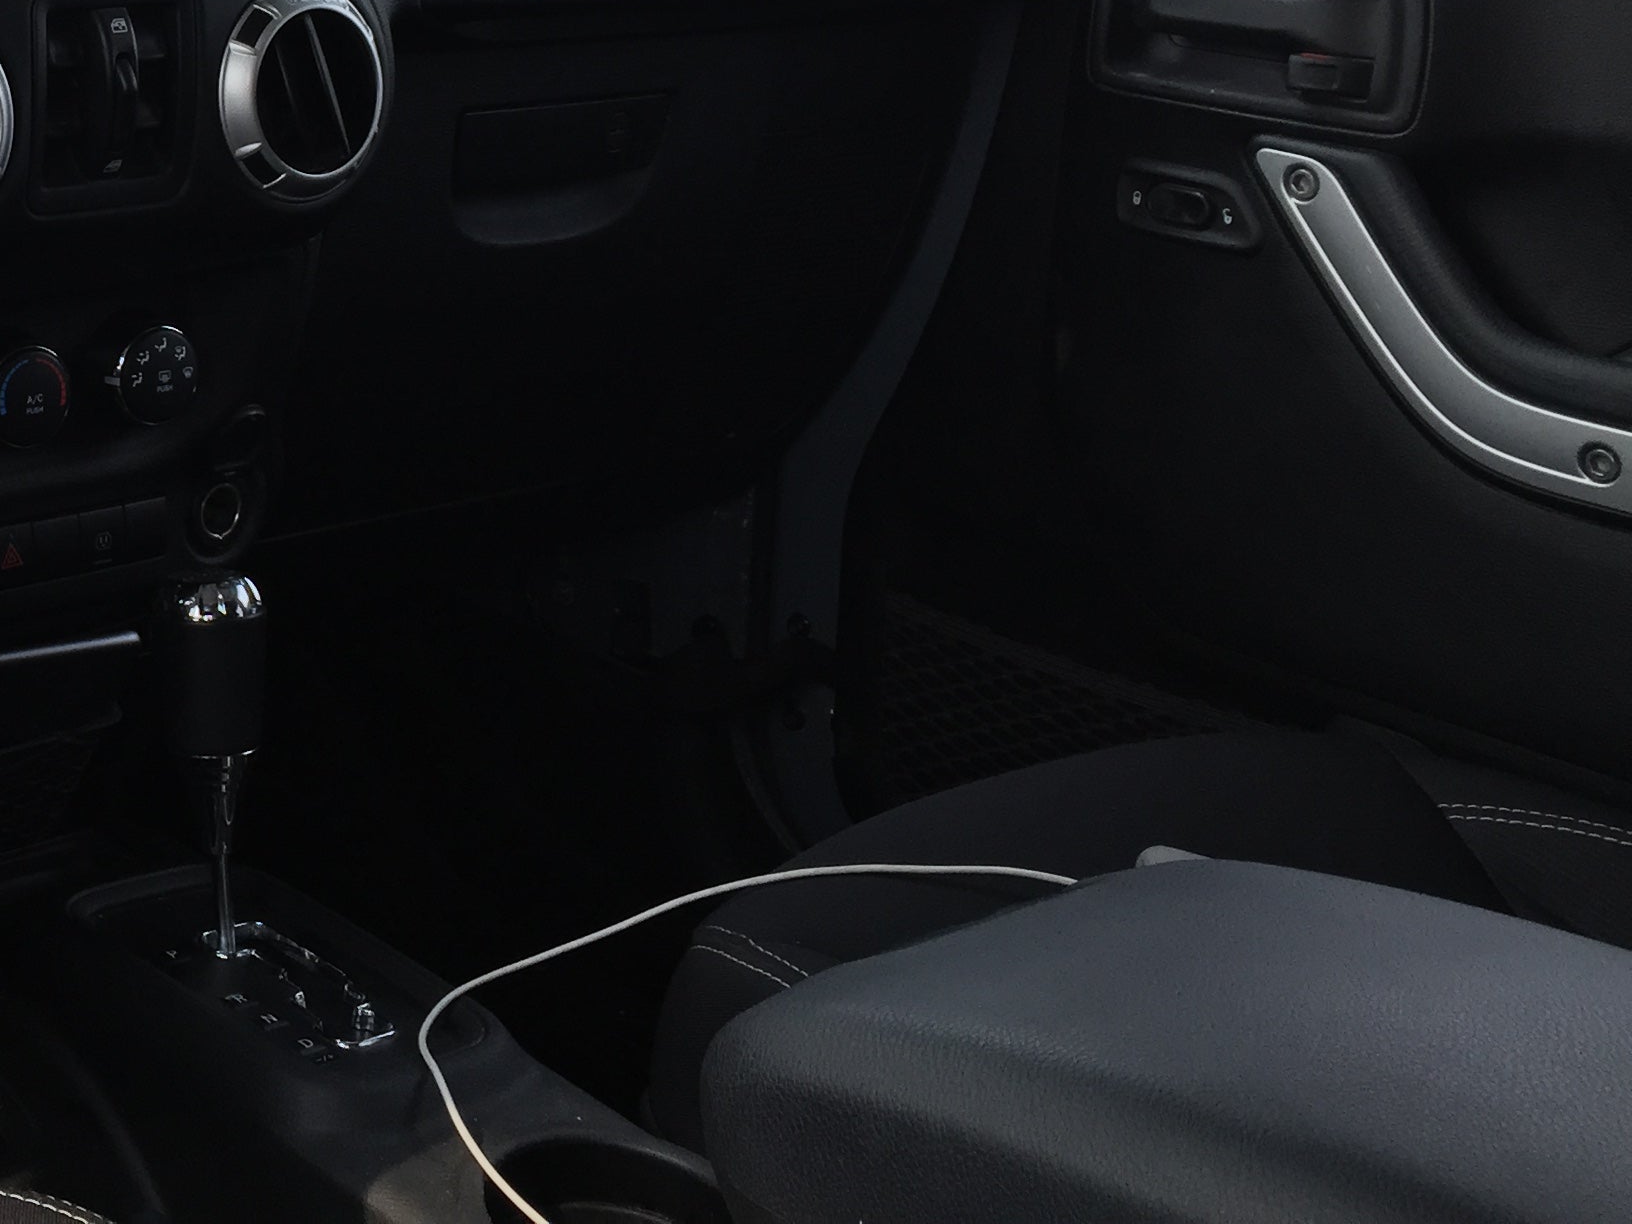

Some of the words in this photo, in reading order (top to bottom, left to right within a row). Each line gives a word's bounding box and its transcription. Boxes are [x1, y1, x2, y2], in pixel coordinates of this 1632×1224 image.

[156, 384, 174, 393] PUSH
[25, 392, 44, 405] A/C
[25, 405, 45, 415] PUSH
[259, 1013, 279, 1024] N
[296, 1038, 315, 1049] D
